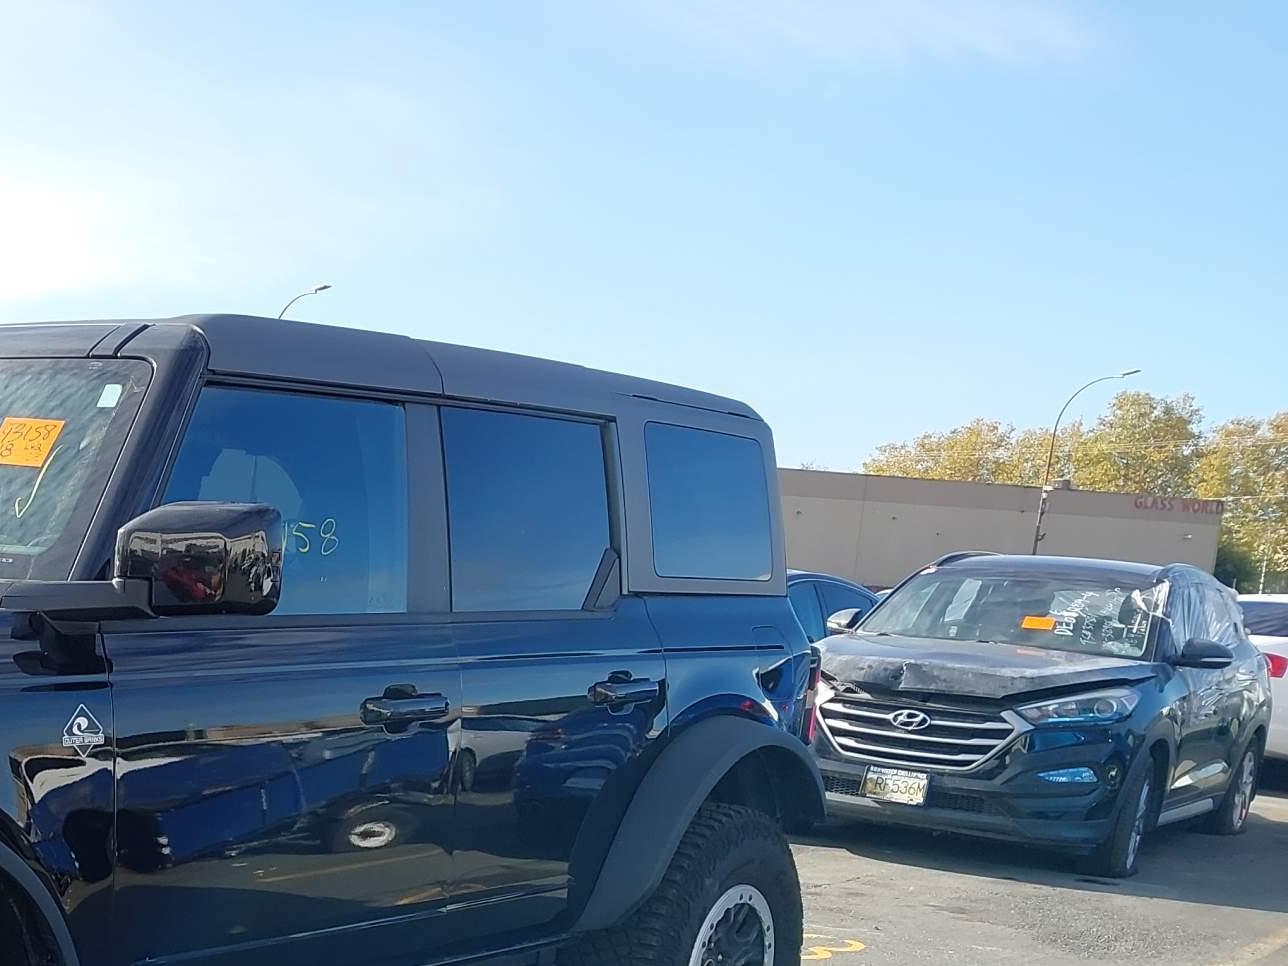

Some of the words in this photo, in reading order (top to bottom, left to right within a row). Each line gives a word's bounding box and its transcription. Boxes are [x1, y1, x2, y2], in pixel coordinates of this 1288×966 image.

[1134, 496, 1174, 512] GLASS
[1182, 500, 1225, 514] WORLD
[875, 776, 925, 797] RF536M
